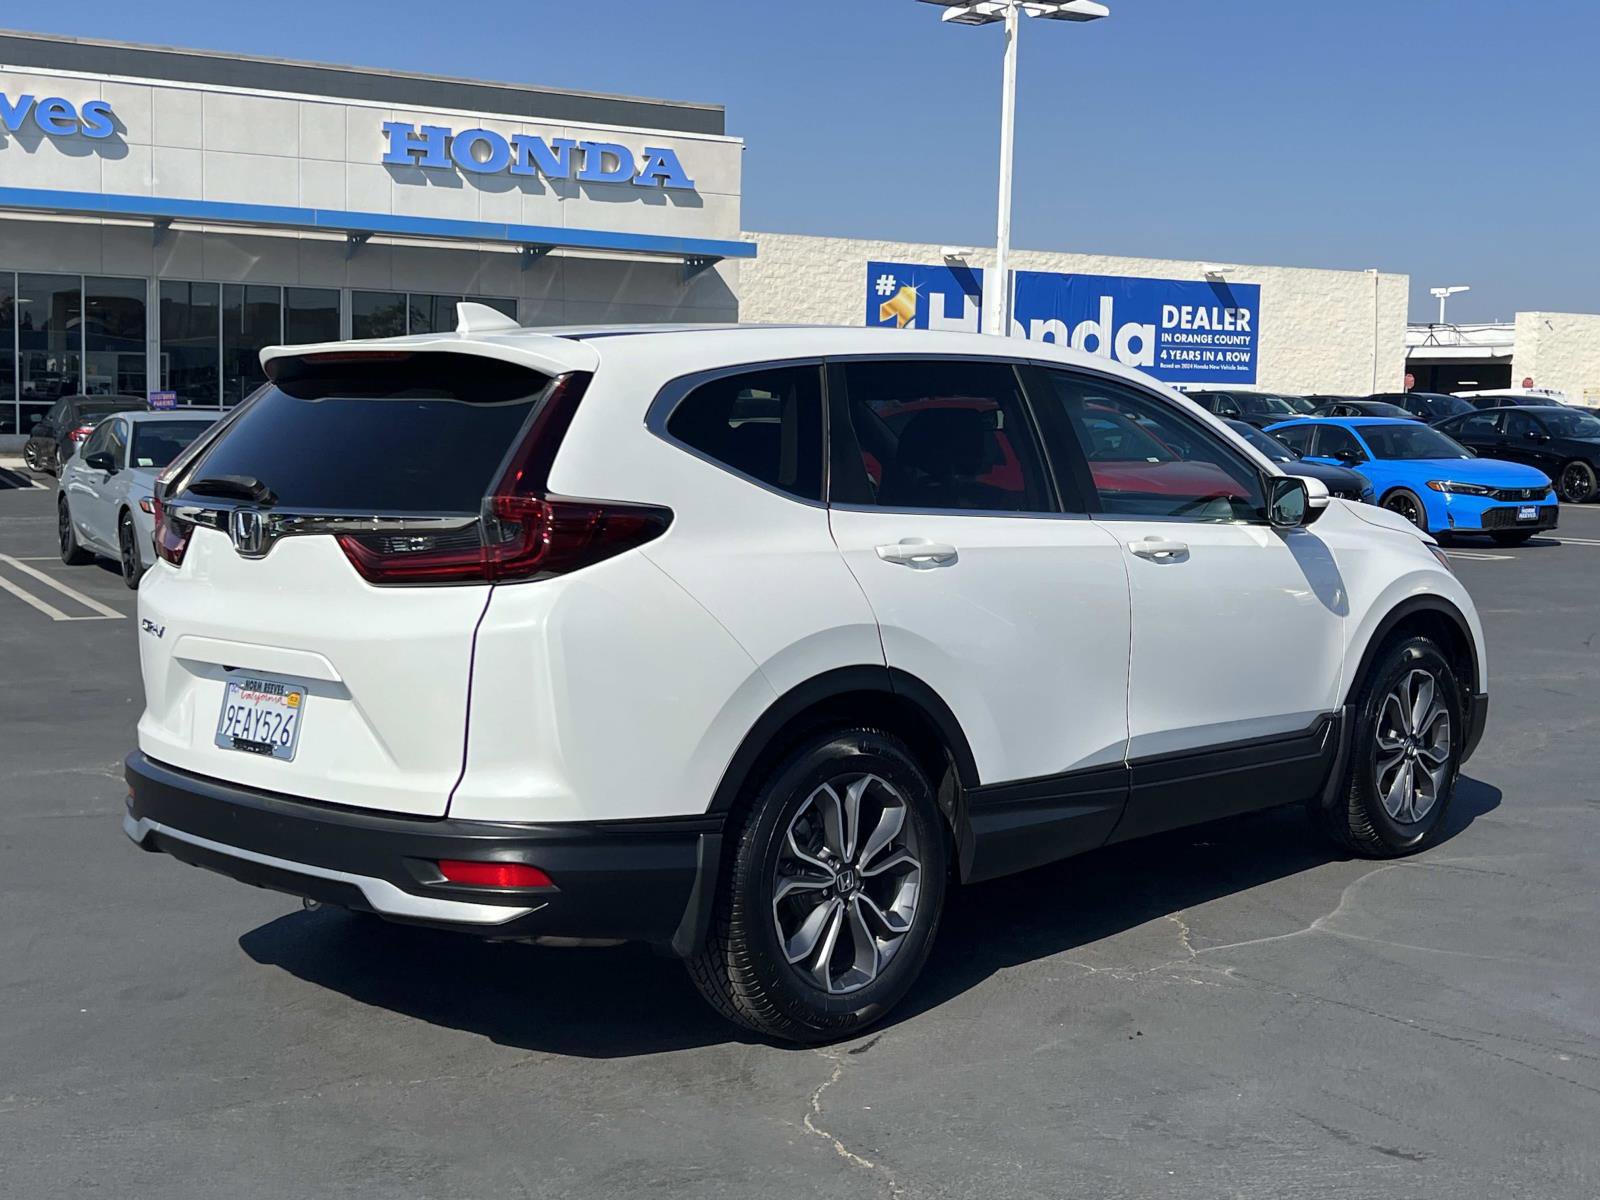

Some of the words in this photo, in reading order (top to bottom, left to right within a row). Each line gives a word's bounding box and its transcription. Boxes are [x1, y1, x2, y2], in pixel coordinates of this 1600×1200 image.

[383, 121, 695, 189] HONDA
[1162, 304, 1251, 332] DEALER
[928, 293, 1156, 367] Hnda
[1161, 333, 1172, 342] IN
[1174, 333, 1213, 344] ORANGE
[1214, 335, 1251, 345] COUNTY
[1160, 350, 1168, 360] 4
[1169, 350, 1201, 361] YEARS
[1202, 351, 1215, 361] IN
[1216, 351, 1224, 362] A
[1226, 352, 1251, 362] ROW
[245, 680, 263, 691] NORM
[263, 682, 284, 695] REEVES
[240, 691, 288, 706] California
[223, 704, 294, 746] 9EAY526
